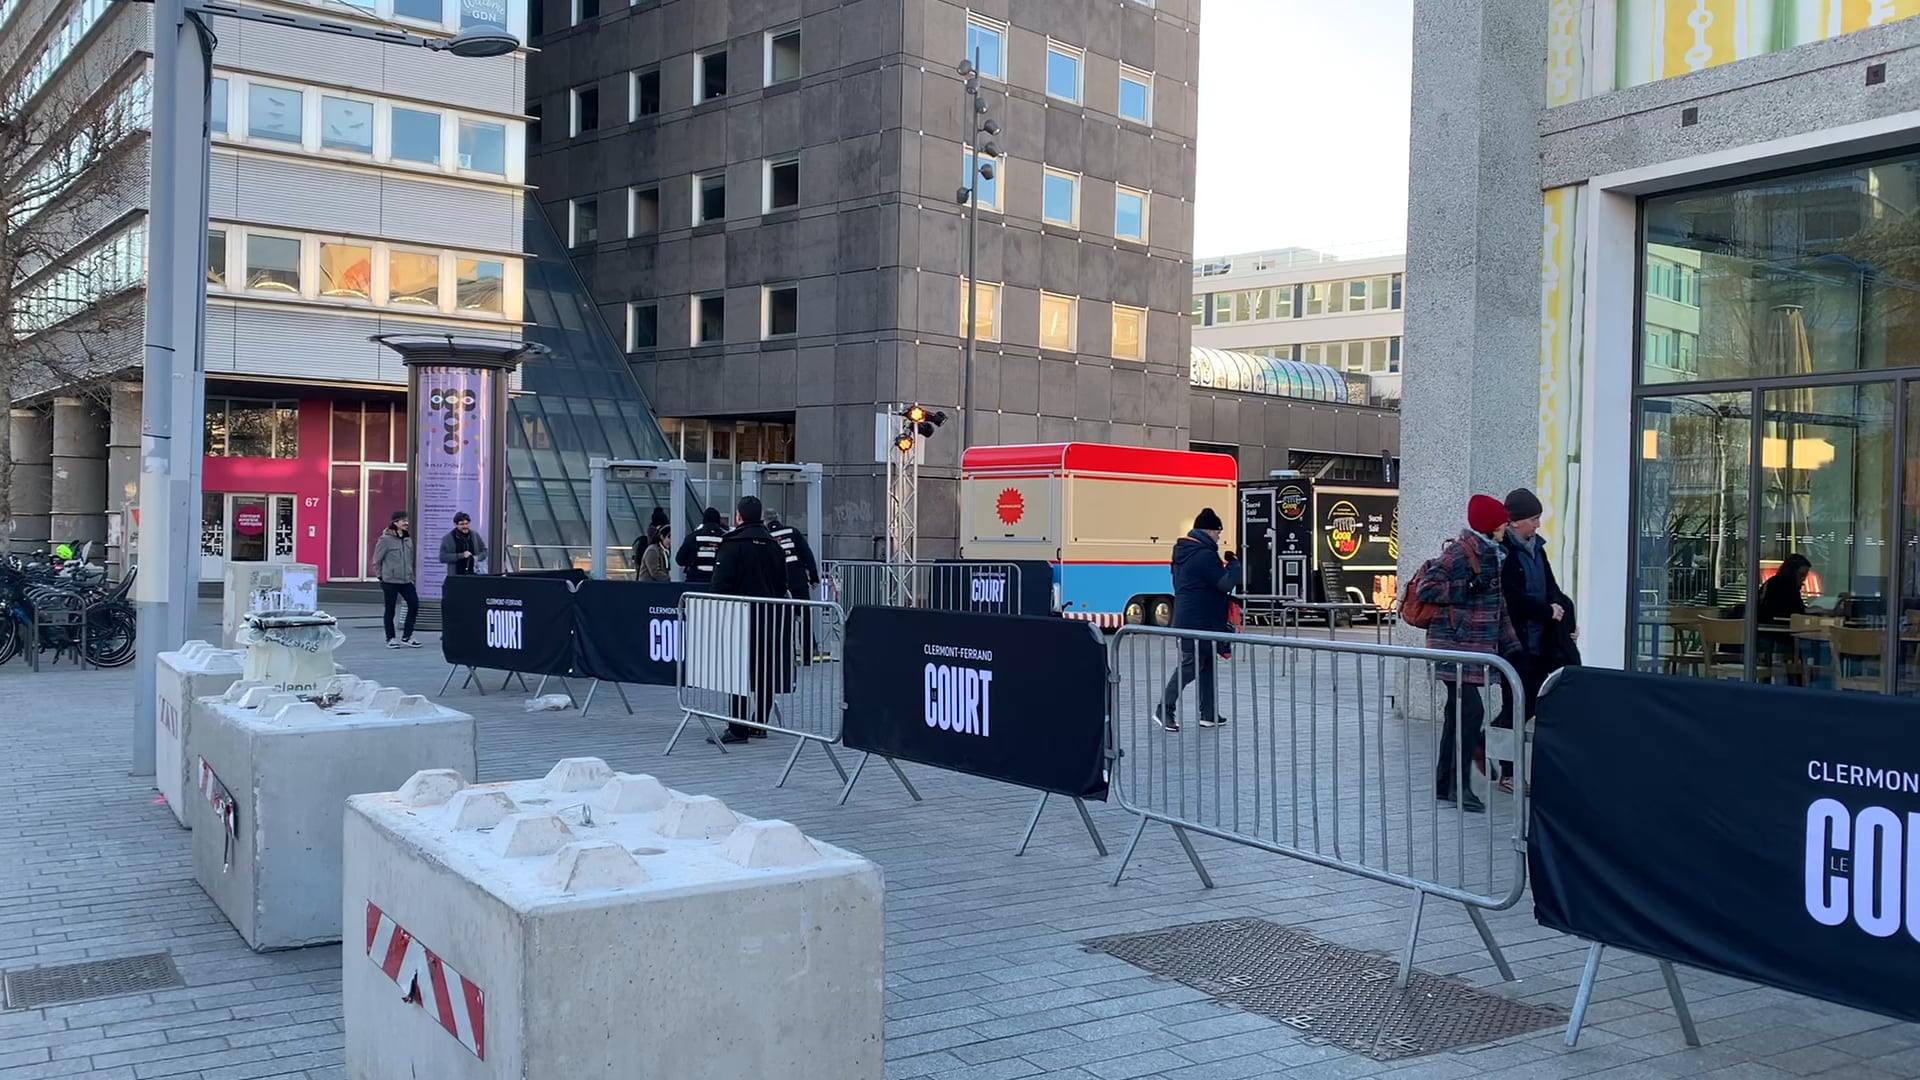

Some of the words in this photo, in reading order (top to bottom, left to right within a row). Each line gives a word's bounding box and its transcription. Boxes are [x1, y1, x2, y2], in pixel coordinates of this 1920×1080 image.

[472, 10, 497, 22] GDN
[305, 497, 320, 507] 67
[972, 578, 1006, 602] COURT
[487, 609, 523, 649] COURT
[923, 643, 993, 661] CLERMONT-FERRAND
[924, 662, 993, 737] COURT
[1807, 760, 1920, 793] CLERMON
[1830, 855, 1849, 873] LE
